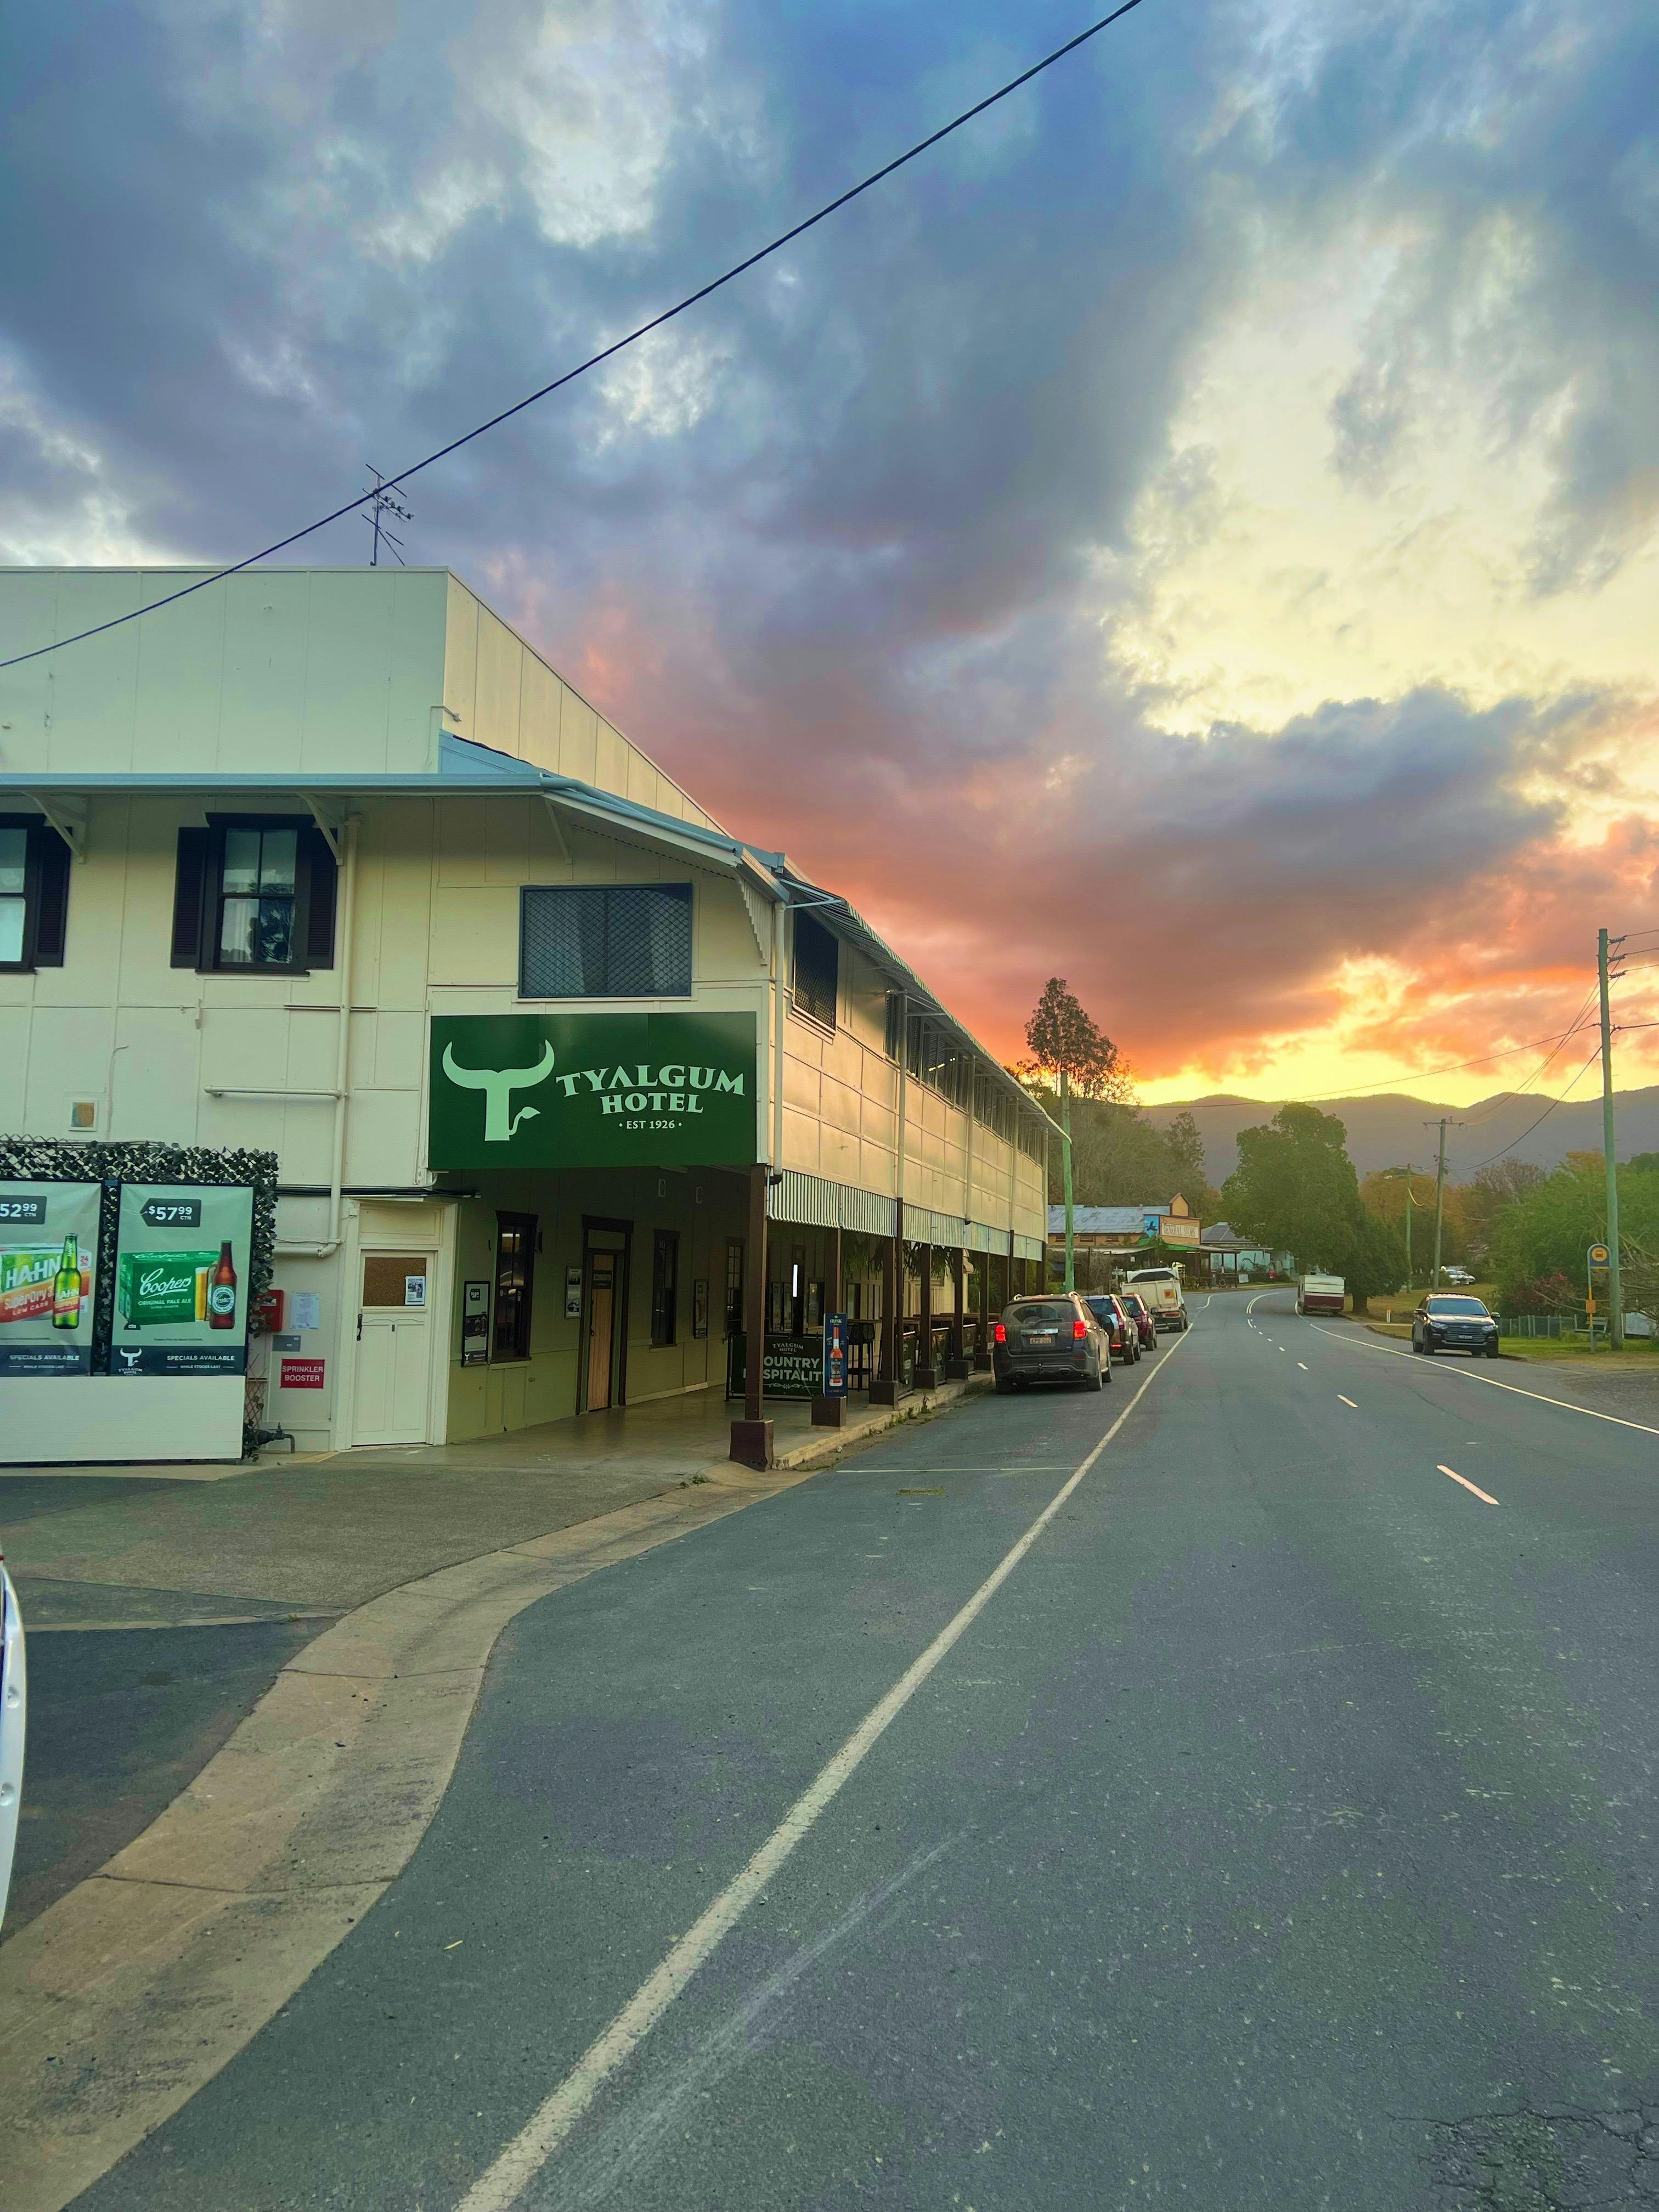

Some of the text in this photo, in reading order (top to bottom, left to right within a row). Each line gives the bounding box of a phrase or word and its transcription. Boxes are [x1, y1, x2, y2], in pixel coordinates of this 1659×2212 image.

[555, 1065, 746, 1097] TYALGUM
[600, 1092, 704, 1115] HOTEL
[626, 1120, 675, 1129] EST 1926
[139, 1268, 192, 1297] Coopers
[13, 1306, 27, 1316] LOW
[764, 1356, 820, 1369] OUNTRY
